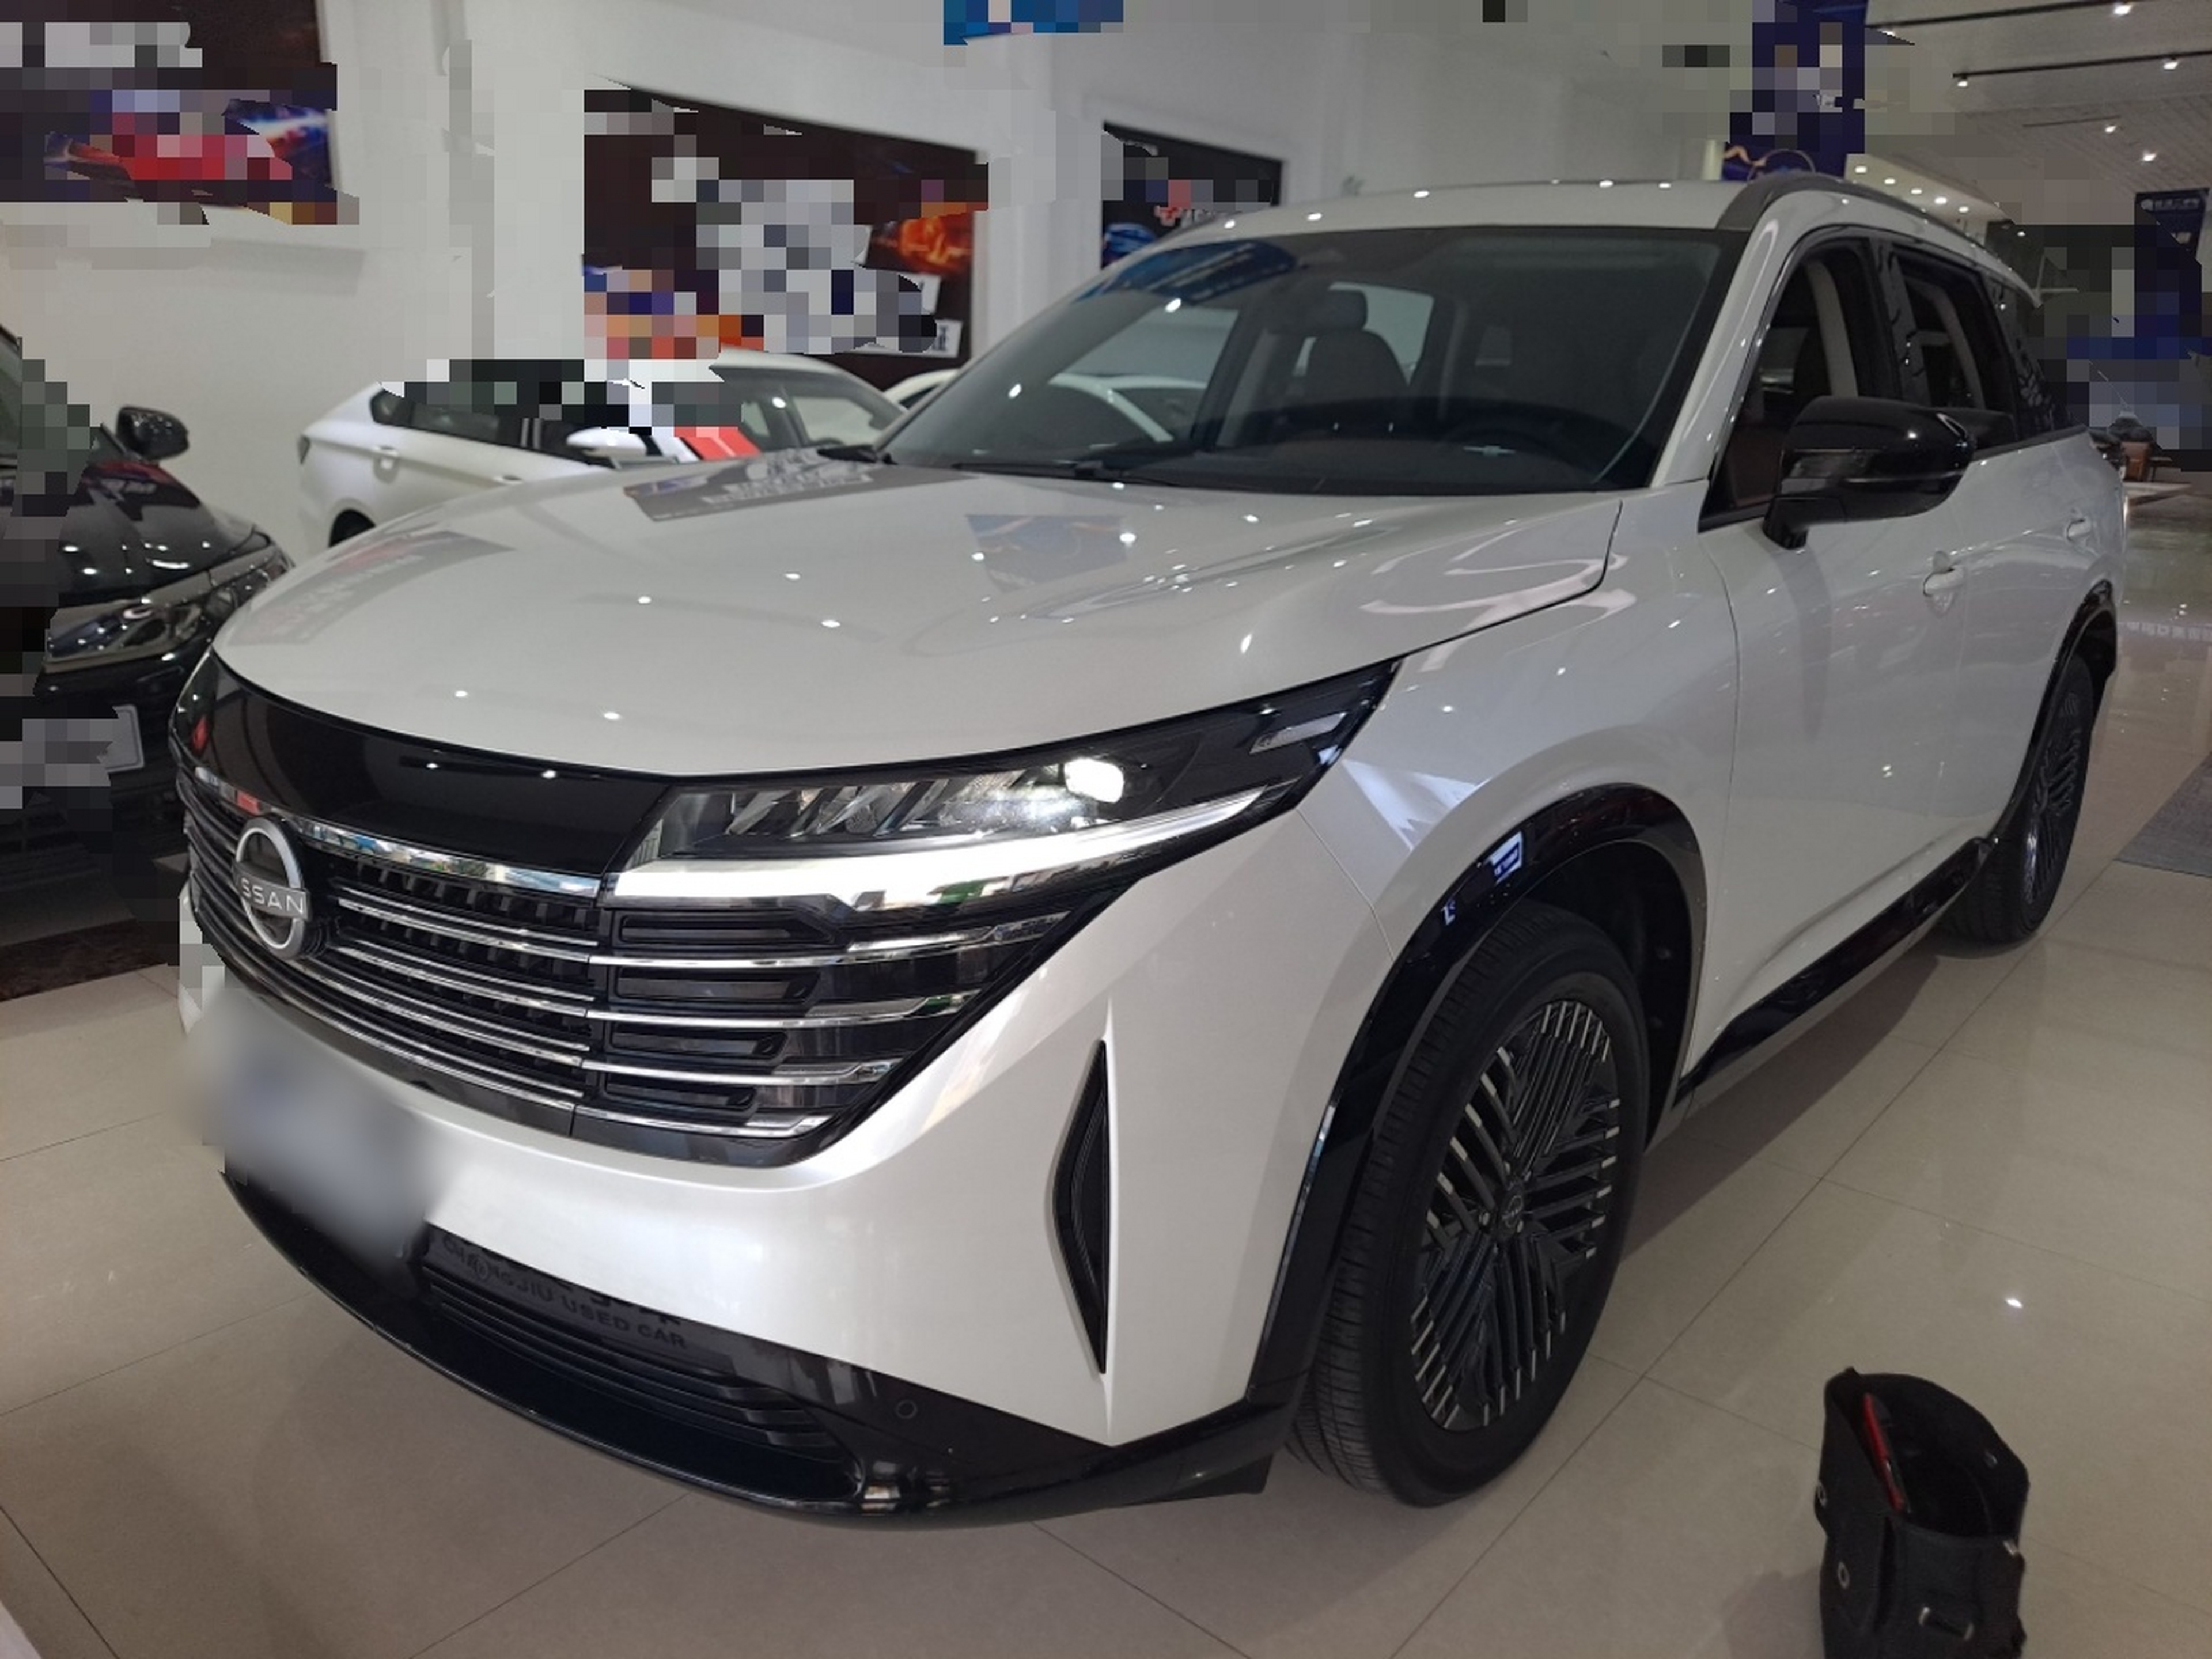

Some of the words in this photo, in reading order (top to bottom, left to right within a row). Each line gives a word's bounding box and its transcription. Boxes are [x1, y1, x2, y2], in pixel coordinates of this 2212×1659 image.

[240, 877, 304, 915] SSAN
[561, 1295, 630, 1331] USED
[637, 1324, 687, 1349] CAR
